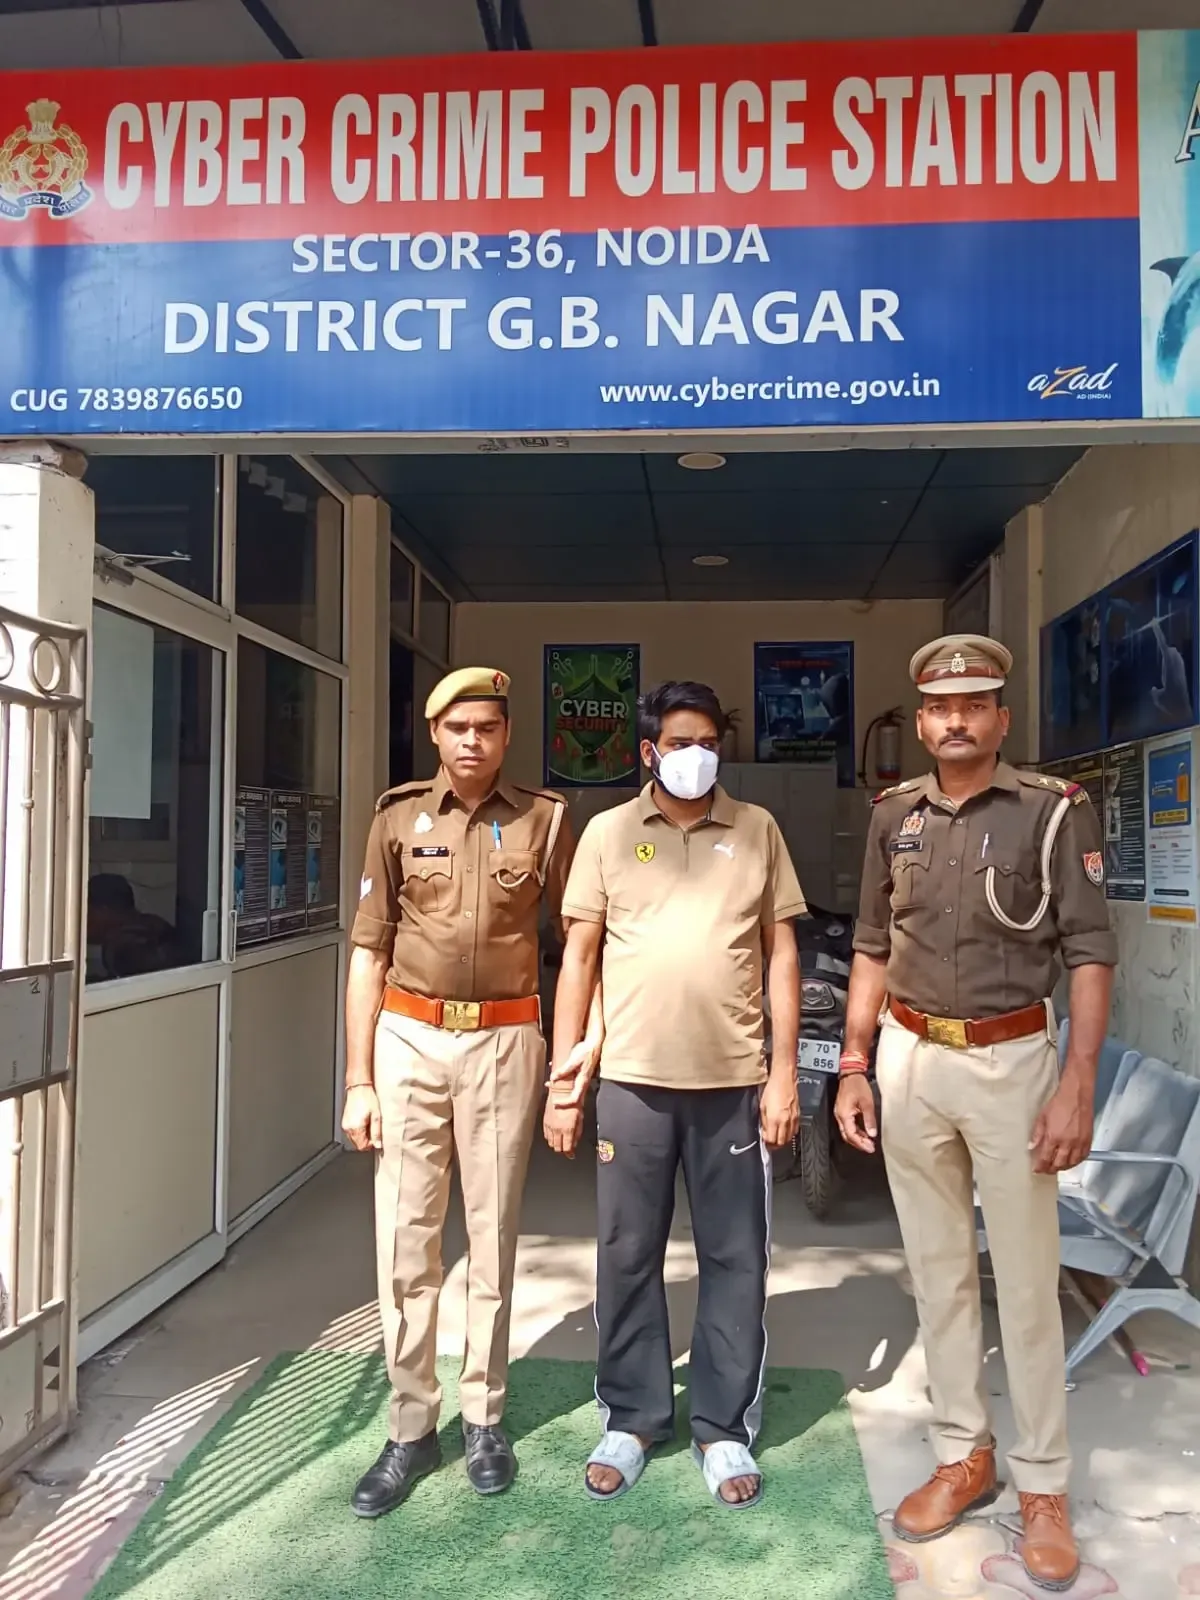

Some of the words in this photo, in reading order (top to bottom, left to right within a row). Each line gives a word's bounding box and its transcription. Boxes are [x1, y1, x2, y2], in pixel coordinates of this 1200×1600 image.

[103, 97, 307, 210] CYBER
[331, 89, 544, 204] CRIME
[569, 80, 807, 197] POLICE
[832, 71, 1117, 191] STATION
[292, 229, 576, 273] SECTOR-36,
[596, 223, 770, 267] NOIDA
[164, 298, 467, 354] DISTRICT
[487, 297, 619, 350] G.B.
[646, 289, 905, 347] NAGAR
[10, 388, 68, 412] CUG
[77, 386, 243, 411] 7839876650
[599, 372, 940, 408] www.cybercrime.gov.in
[560, 699, 625, 719] CYBER
[813, 1057, 834, 1069] 856
[816, 1043, 830, 1054] 70
